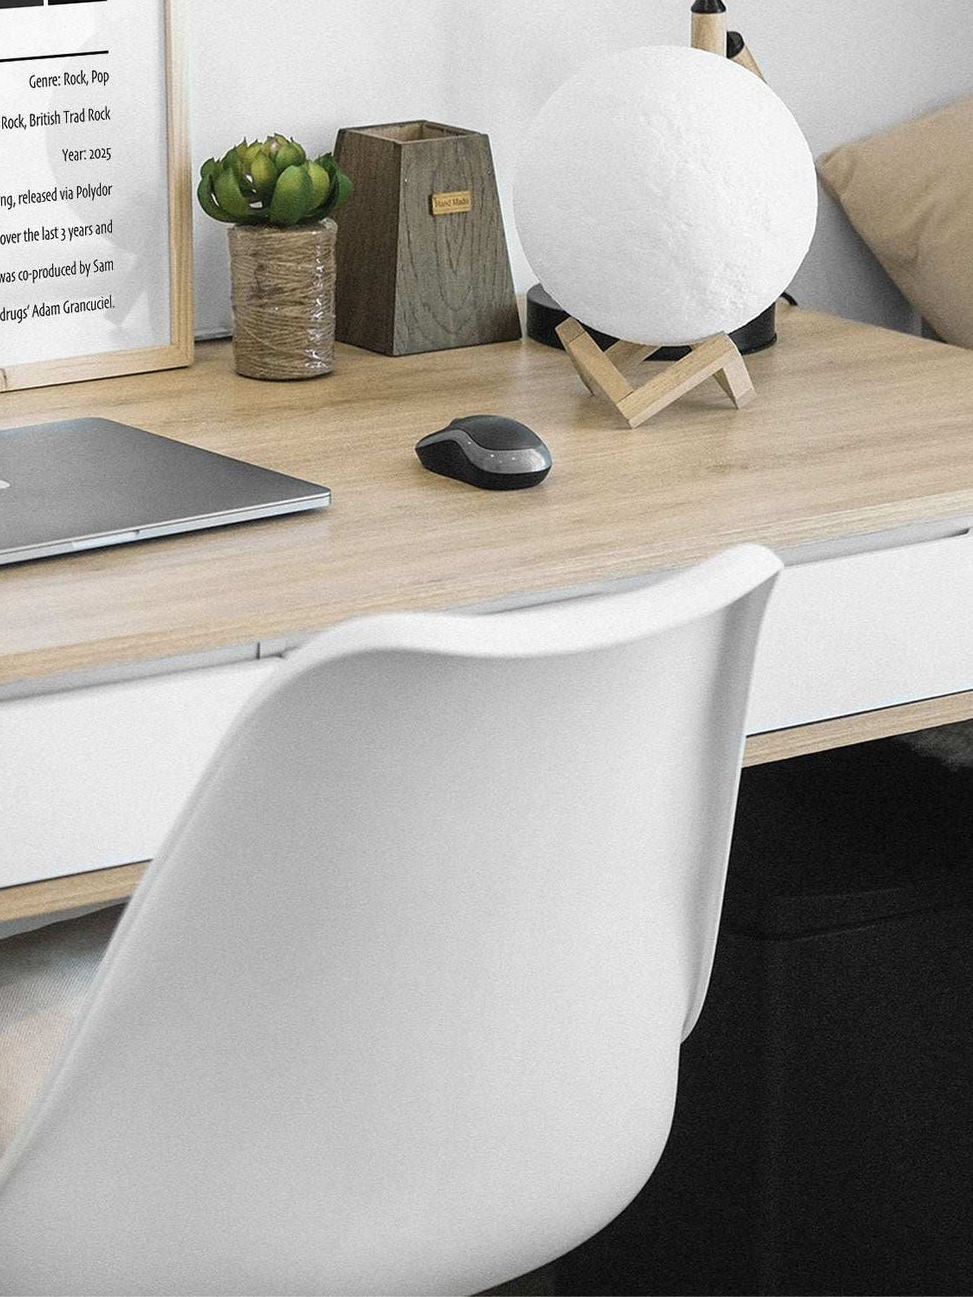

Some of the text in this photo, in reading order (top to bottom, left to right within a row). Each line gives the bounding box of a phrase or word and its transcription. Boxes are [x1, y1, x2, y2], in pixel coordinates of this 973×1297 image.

[28, 69, 110, 89] Genre: Rock, Pop
[1, 113, 27, 130] Rock,
[29, 110, 61, 128] British
[62, 107, 86, 124] Trad
[87, 105, 111, 122] Rock
[61, 147, 112, 163] Year: 2025
[18, 186, 58, 205] released
[59, 189, 74, 201] via
[76, 182, 113, 202] Polydor
[0, 232, 22, 246] over
[23, 227, 40, 243] the
[41, 226, 60, 241] last
[60, 227, 67, 242] 3
[67, 224, 94, 242] years
[94, 218, 113, 236] and
[17, 260, 77, 284] co-produced
[79, 259, 92, 278] by
[92, 258, 114, 274] Sam
[31, 302, 61, 318] Adam
[62, 294, 116, 315] Grancuciel.
